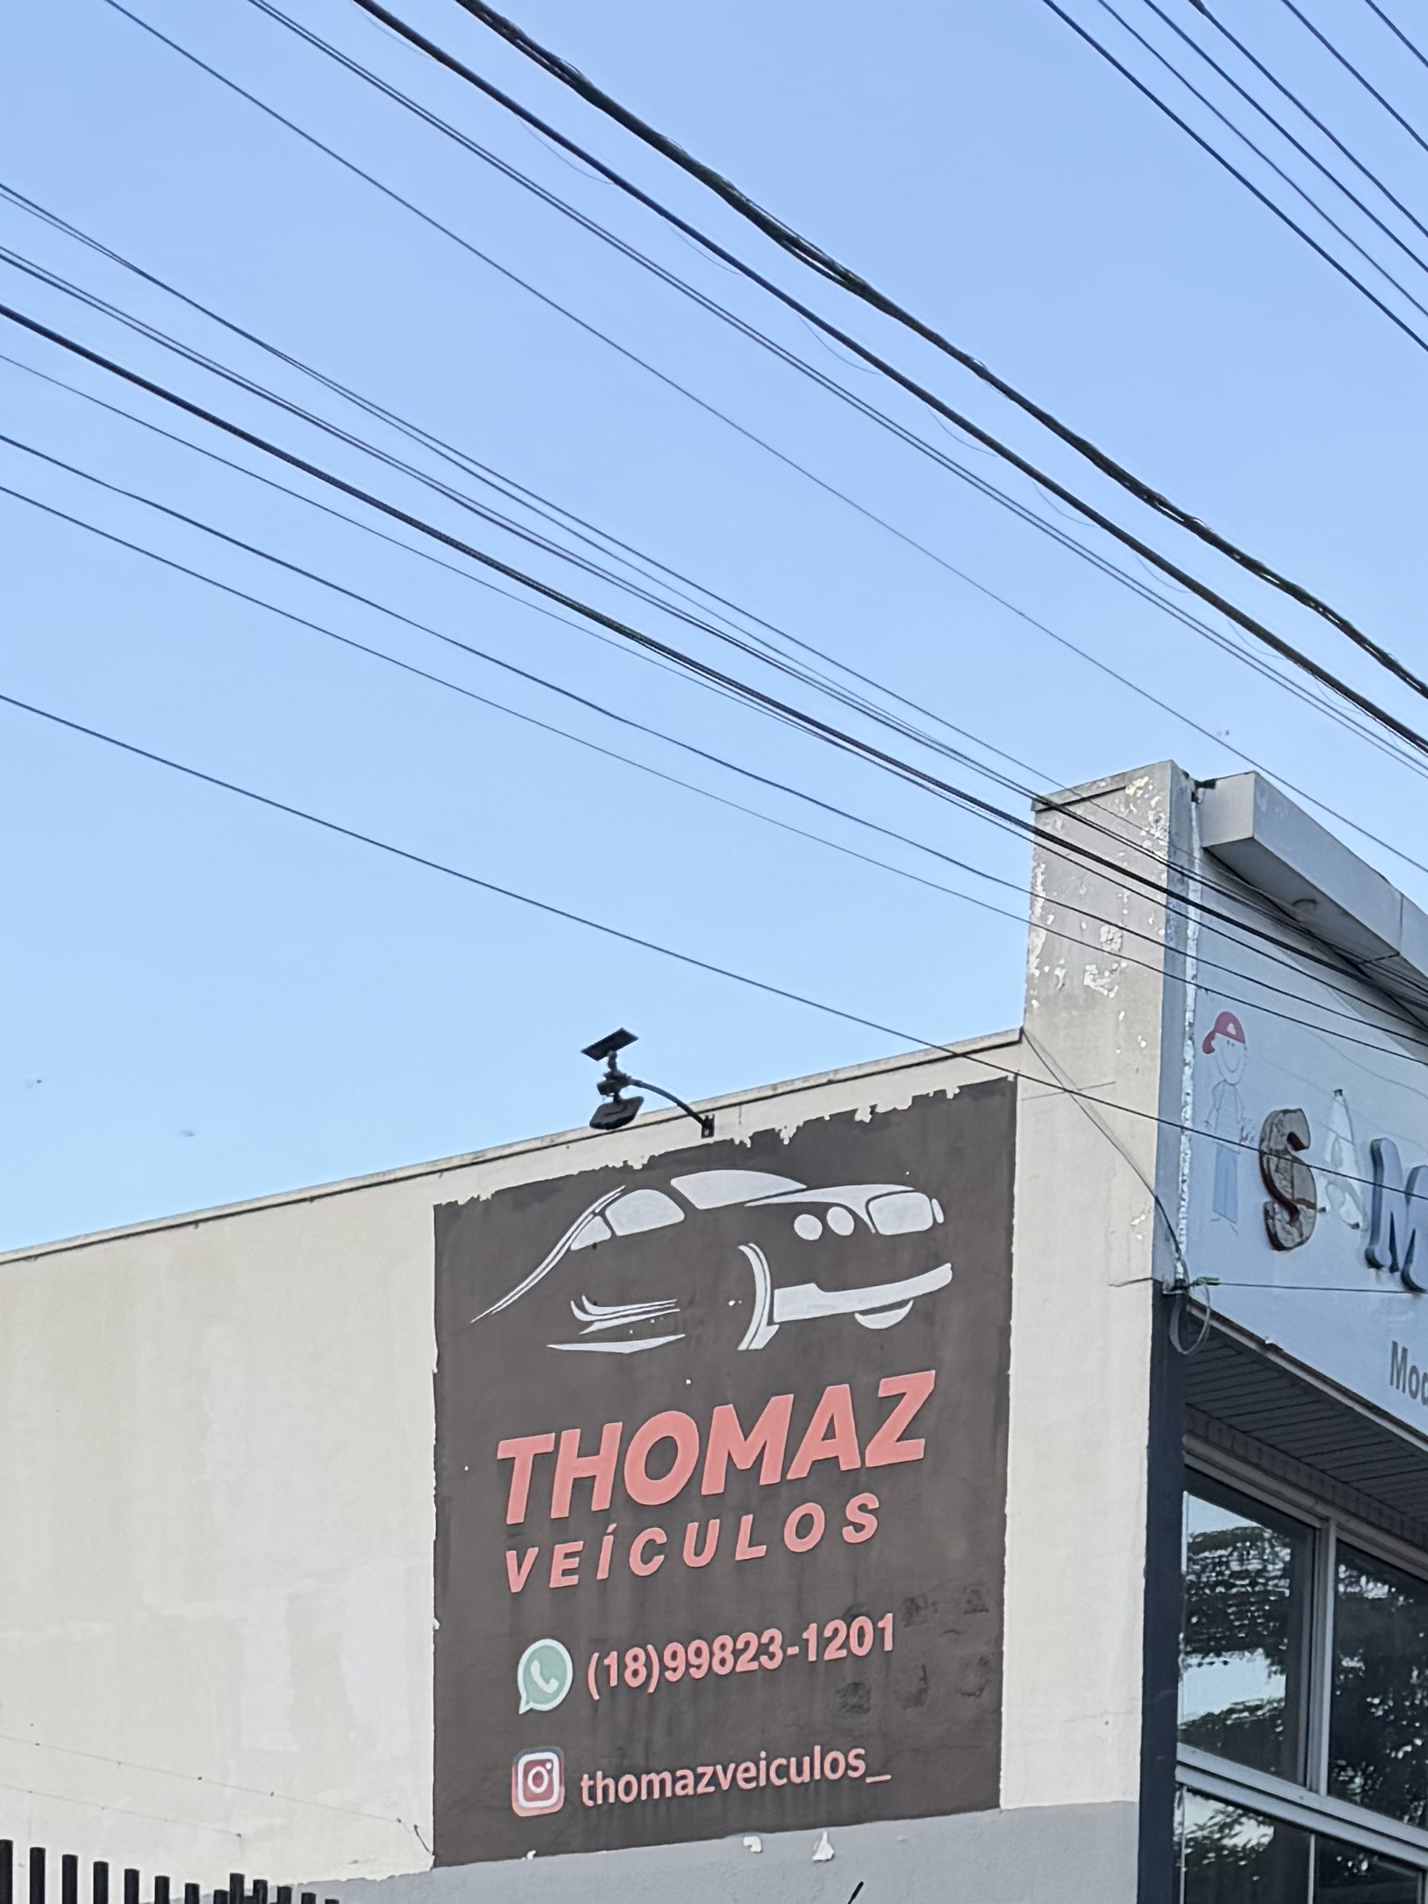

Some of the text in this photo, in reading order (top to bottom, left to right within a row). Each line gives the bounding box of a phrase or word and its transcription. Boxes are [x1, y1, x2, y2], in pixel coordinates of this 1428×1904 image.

[496, 1370, 936, 1525] THOMAZ
[505, 1492, 880, 1593] VEÍCULOS
[586, 1613, 895, 1701] (18)99823-1201
[580, 1746, 892, 1808] thomazveiculos_
